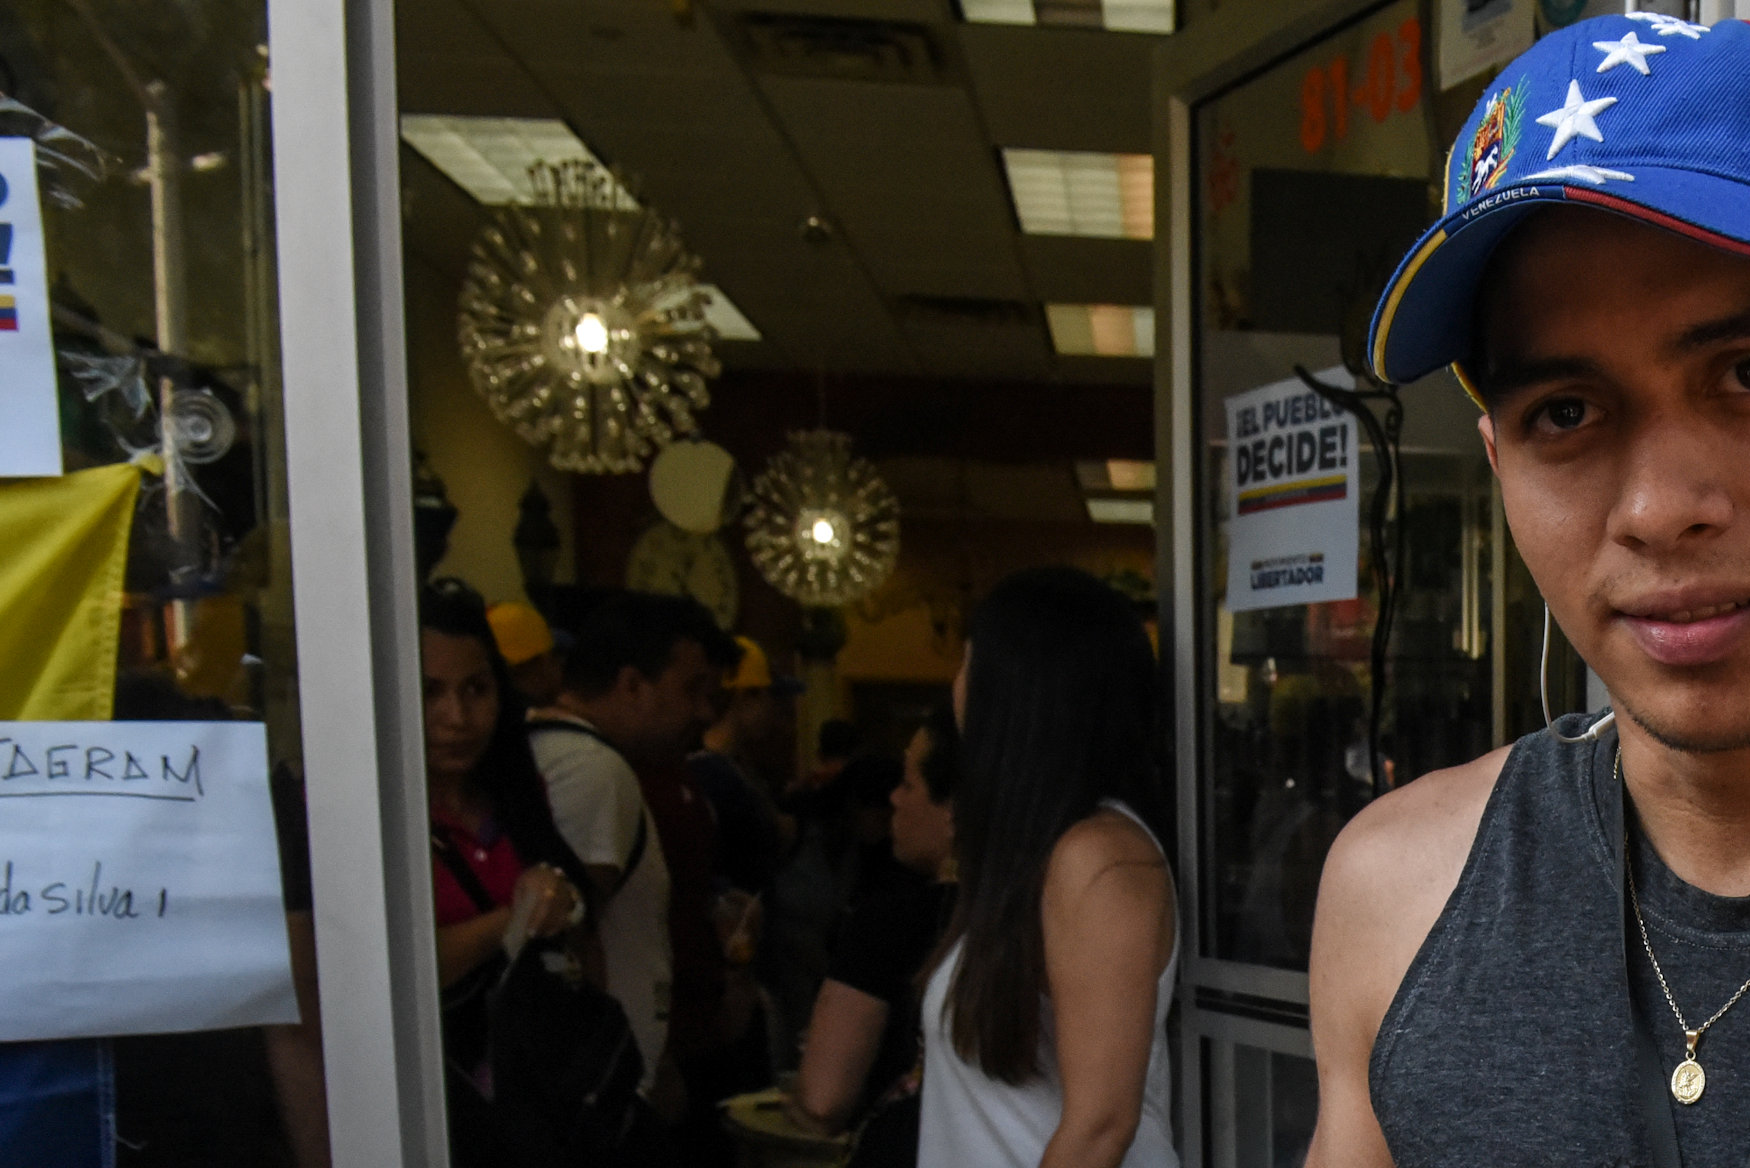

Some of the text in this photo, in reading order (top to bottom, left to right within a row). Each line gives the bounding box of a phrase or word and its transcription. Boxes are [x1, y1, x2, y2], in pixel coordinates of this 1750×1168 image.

[1461, 185, 1540, 221] VENEZUELA
[1236, 423, 1348, 488] DECIDE!
[1250, 564, 1325, 591] LIBERTADOR
